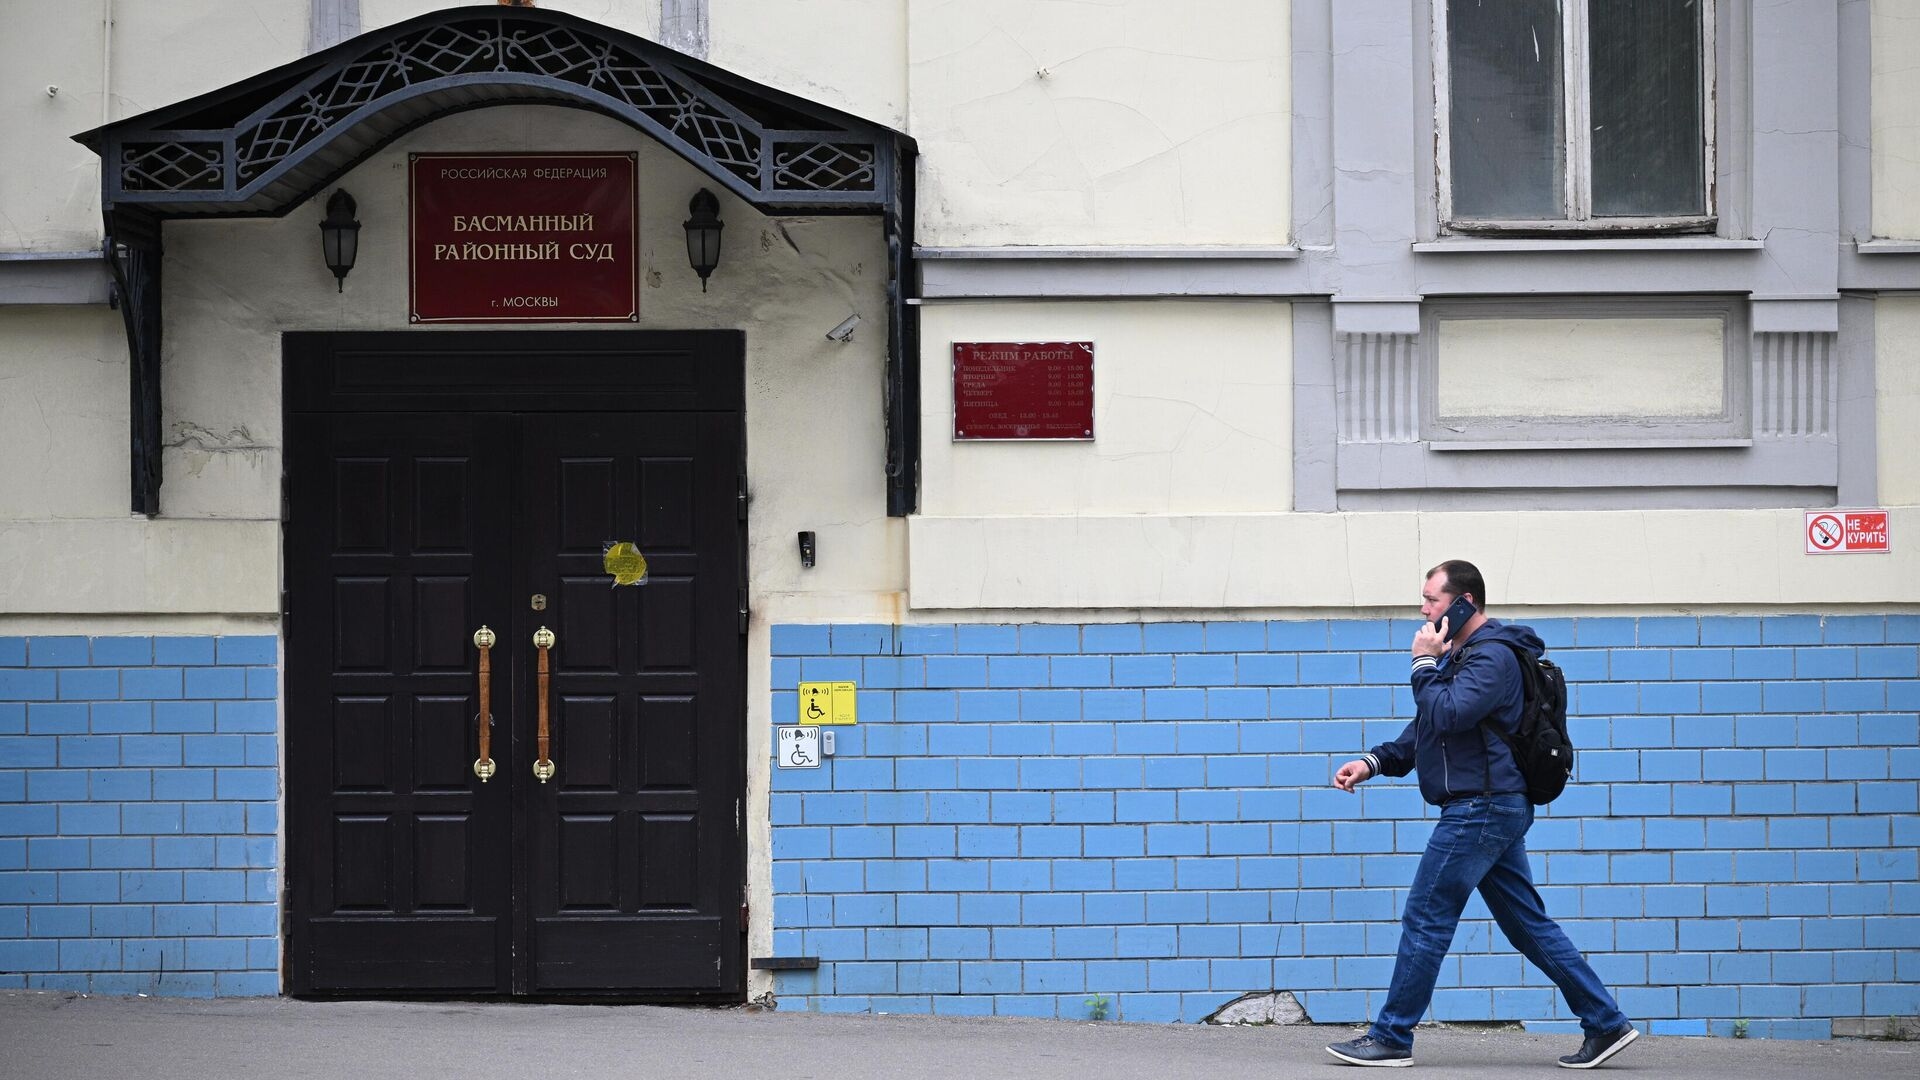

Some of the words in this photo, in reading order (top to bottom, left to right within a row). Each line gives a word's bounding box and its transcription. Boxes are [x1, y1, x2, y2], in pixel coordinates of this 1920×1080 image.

[441, 167, 527, 180] РОССИЙСКАЯ
[533, 167, 607, 180] ФЕДЕРАЦИЯ
[453, 212, 594, 232] БАСМАННЫЙ
[434, 241, 560, 261] РАЙОННЫЙ
[569, 243, 615, 263] СУД
[491, 299, 499, 308] г.
[503, 296, 558, 308] МОСКВЫ
[973, 351, 1019, 361] РЕЖИМ
[1024, 350, 1074, 361] РАБОТЫ
[1847, 519, 1860, 531] НЕ
[1847, 532, 1886, 544] КУРИТЬ
